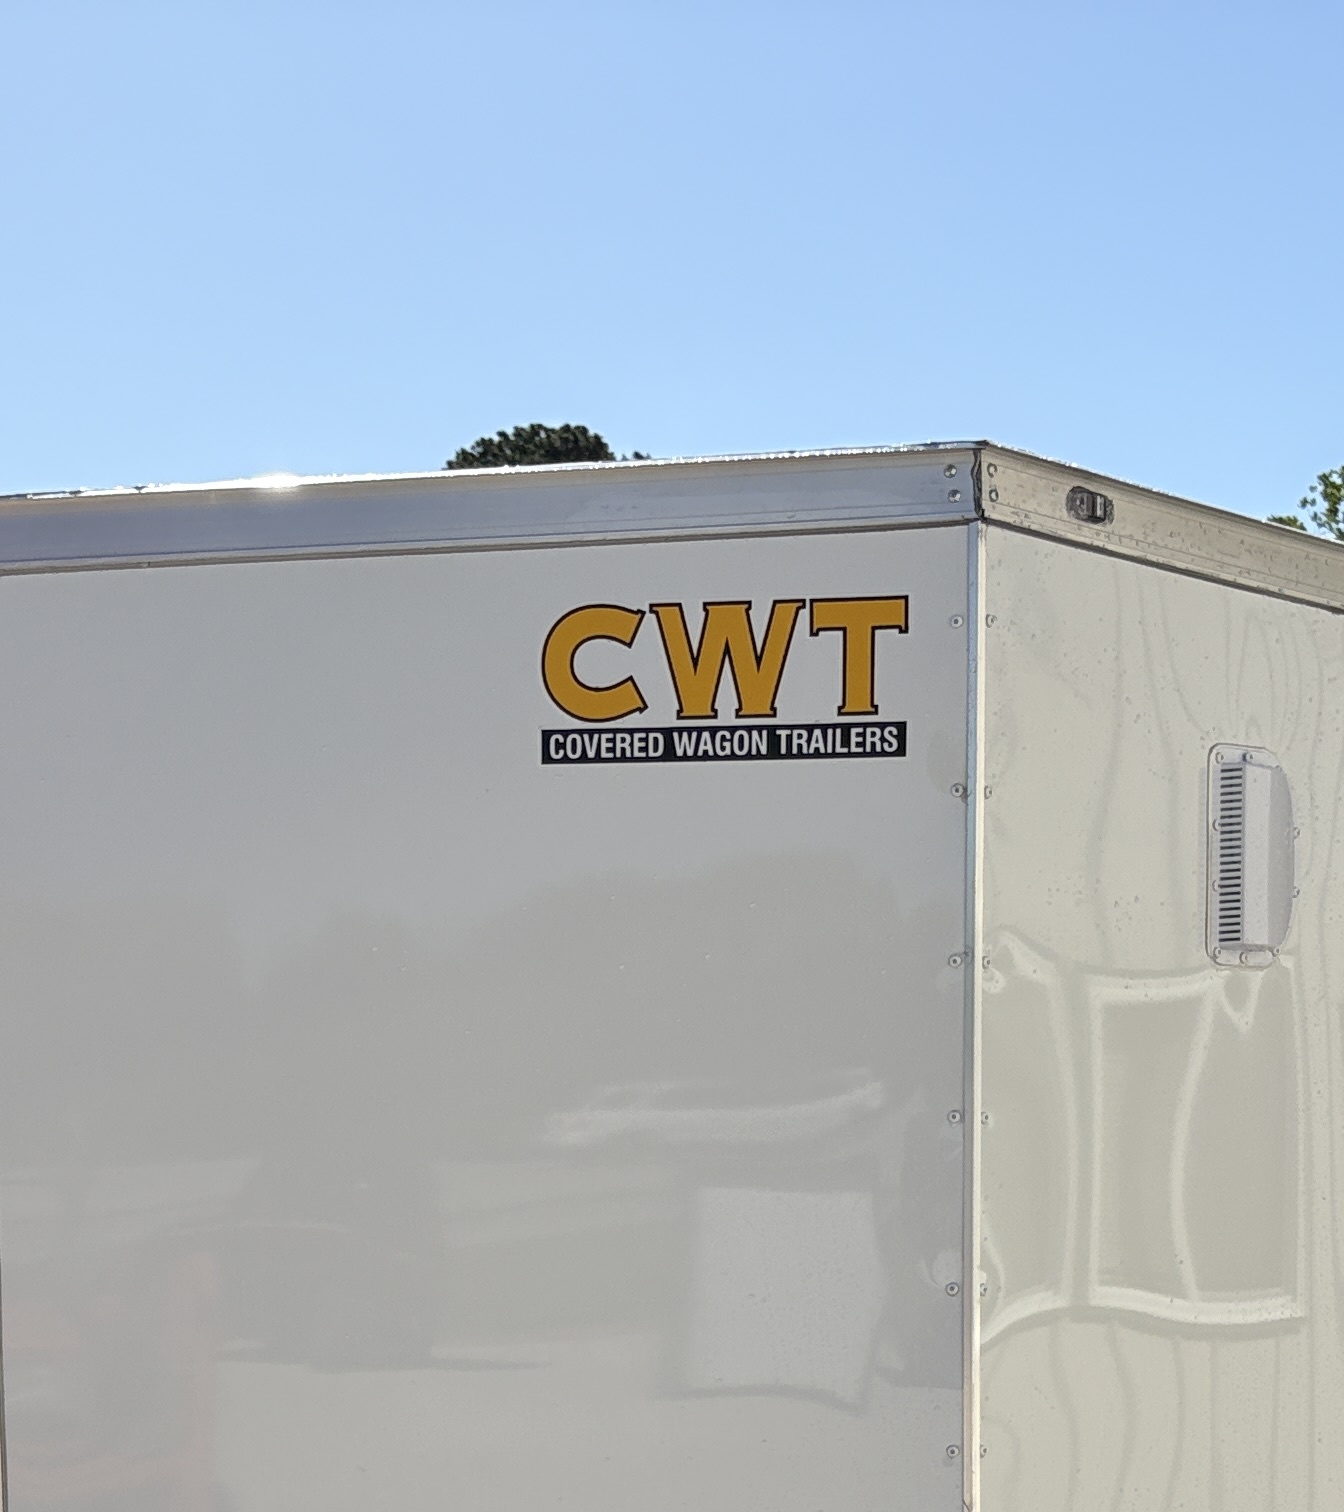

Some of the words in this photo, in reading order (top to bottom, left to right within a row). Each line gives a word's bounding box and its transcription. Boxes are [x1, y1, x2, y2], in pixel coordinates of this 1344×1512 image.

[542, 595, 909, 723] CWT
[549, 731, 664, 760] COVERED
[673, 729, 768, 757] WAGON
[776, 726, 899, 755] TRAILERS
